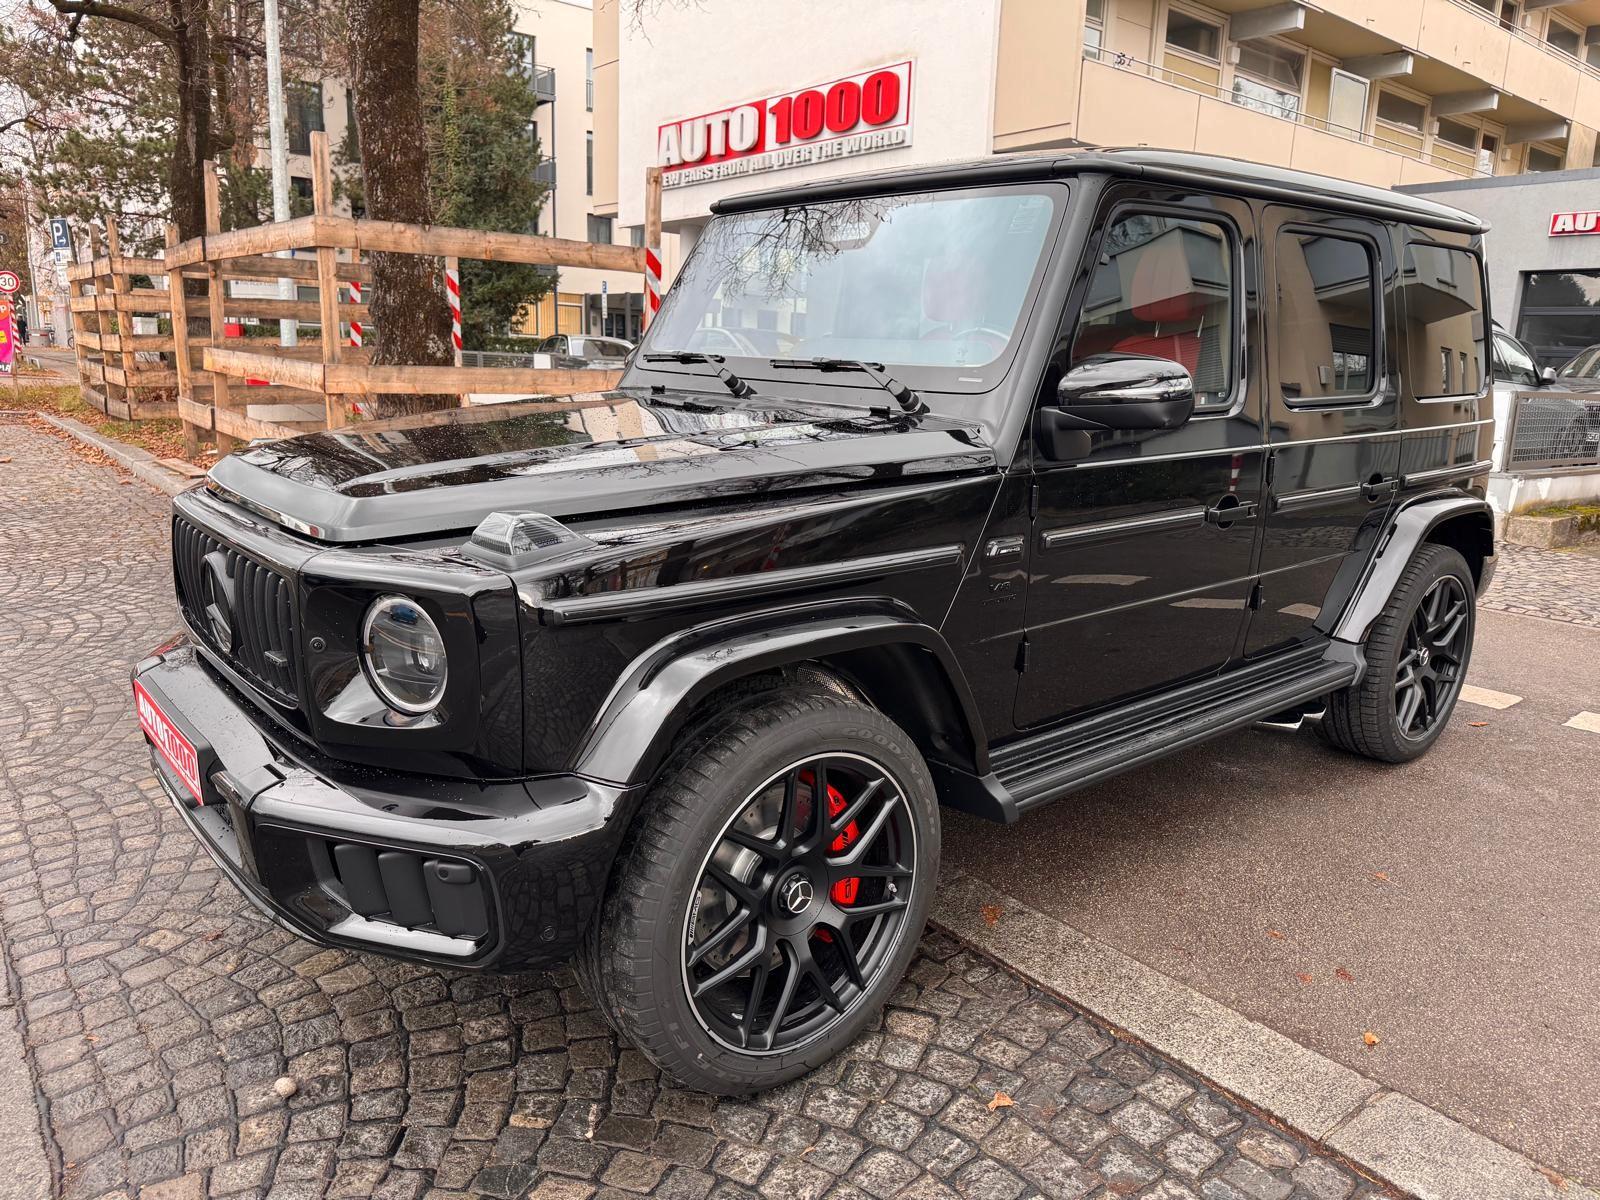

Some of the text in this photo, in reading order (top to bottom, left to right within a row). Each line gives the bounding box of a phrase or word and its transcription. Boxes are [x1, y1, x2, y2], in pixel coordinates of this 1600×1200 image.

[658, 71, 900, 167] AUTO 1000
[662, 129, 905, 187] EW CARS FROM ALL OVER THE WORLD
[52, 222, 63, 246] P
[1552, 213, 1600, 231] AU
[0, 276, 14, 288] 30
